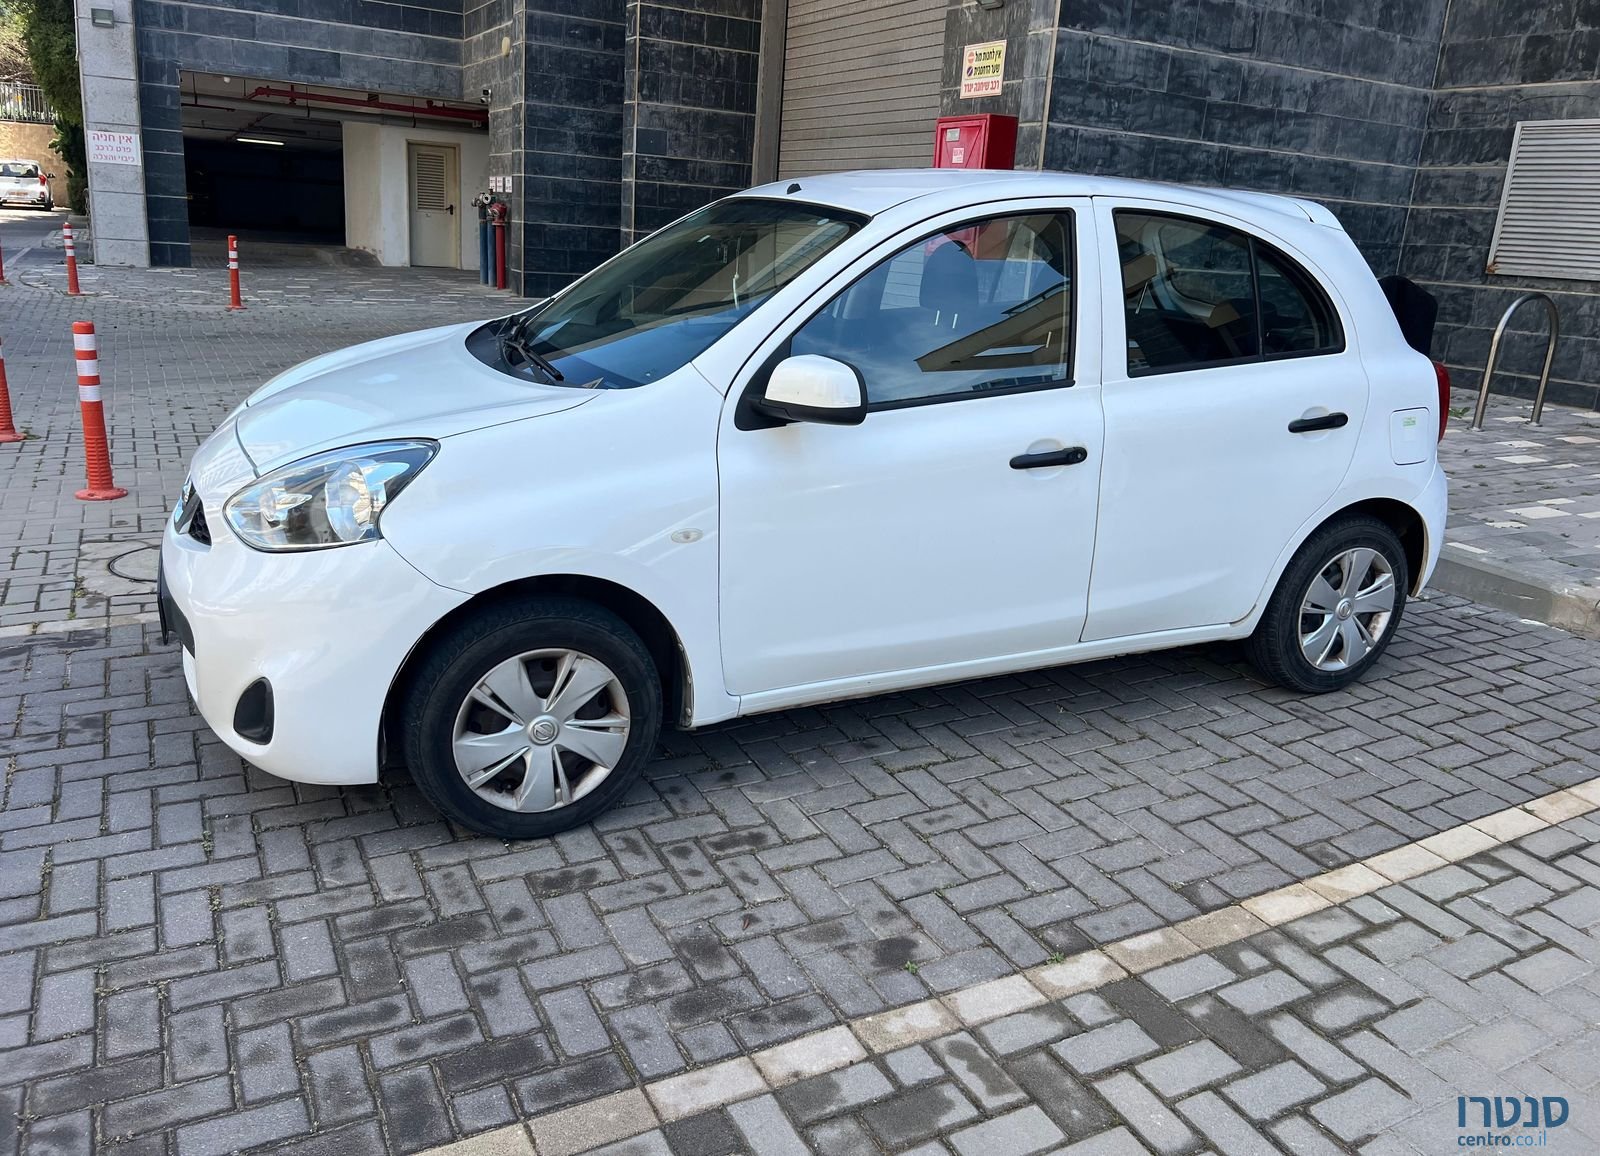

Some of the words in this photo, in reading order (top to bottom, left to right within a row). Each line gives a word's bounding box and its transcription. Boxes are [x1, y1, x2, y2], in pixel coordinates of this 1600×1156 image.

[975, 51, 983, 62] מול
[983, 48, 995, 61] לחנות
[994, 50, 1002, 62] אין
[991, 64, 1000, 74] שער
[990, 80, 1000, 90] רכב
[92, 133, 115, 142] חניה
[119, 135, 132, 144] אין
